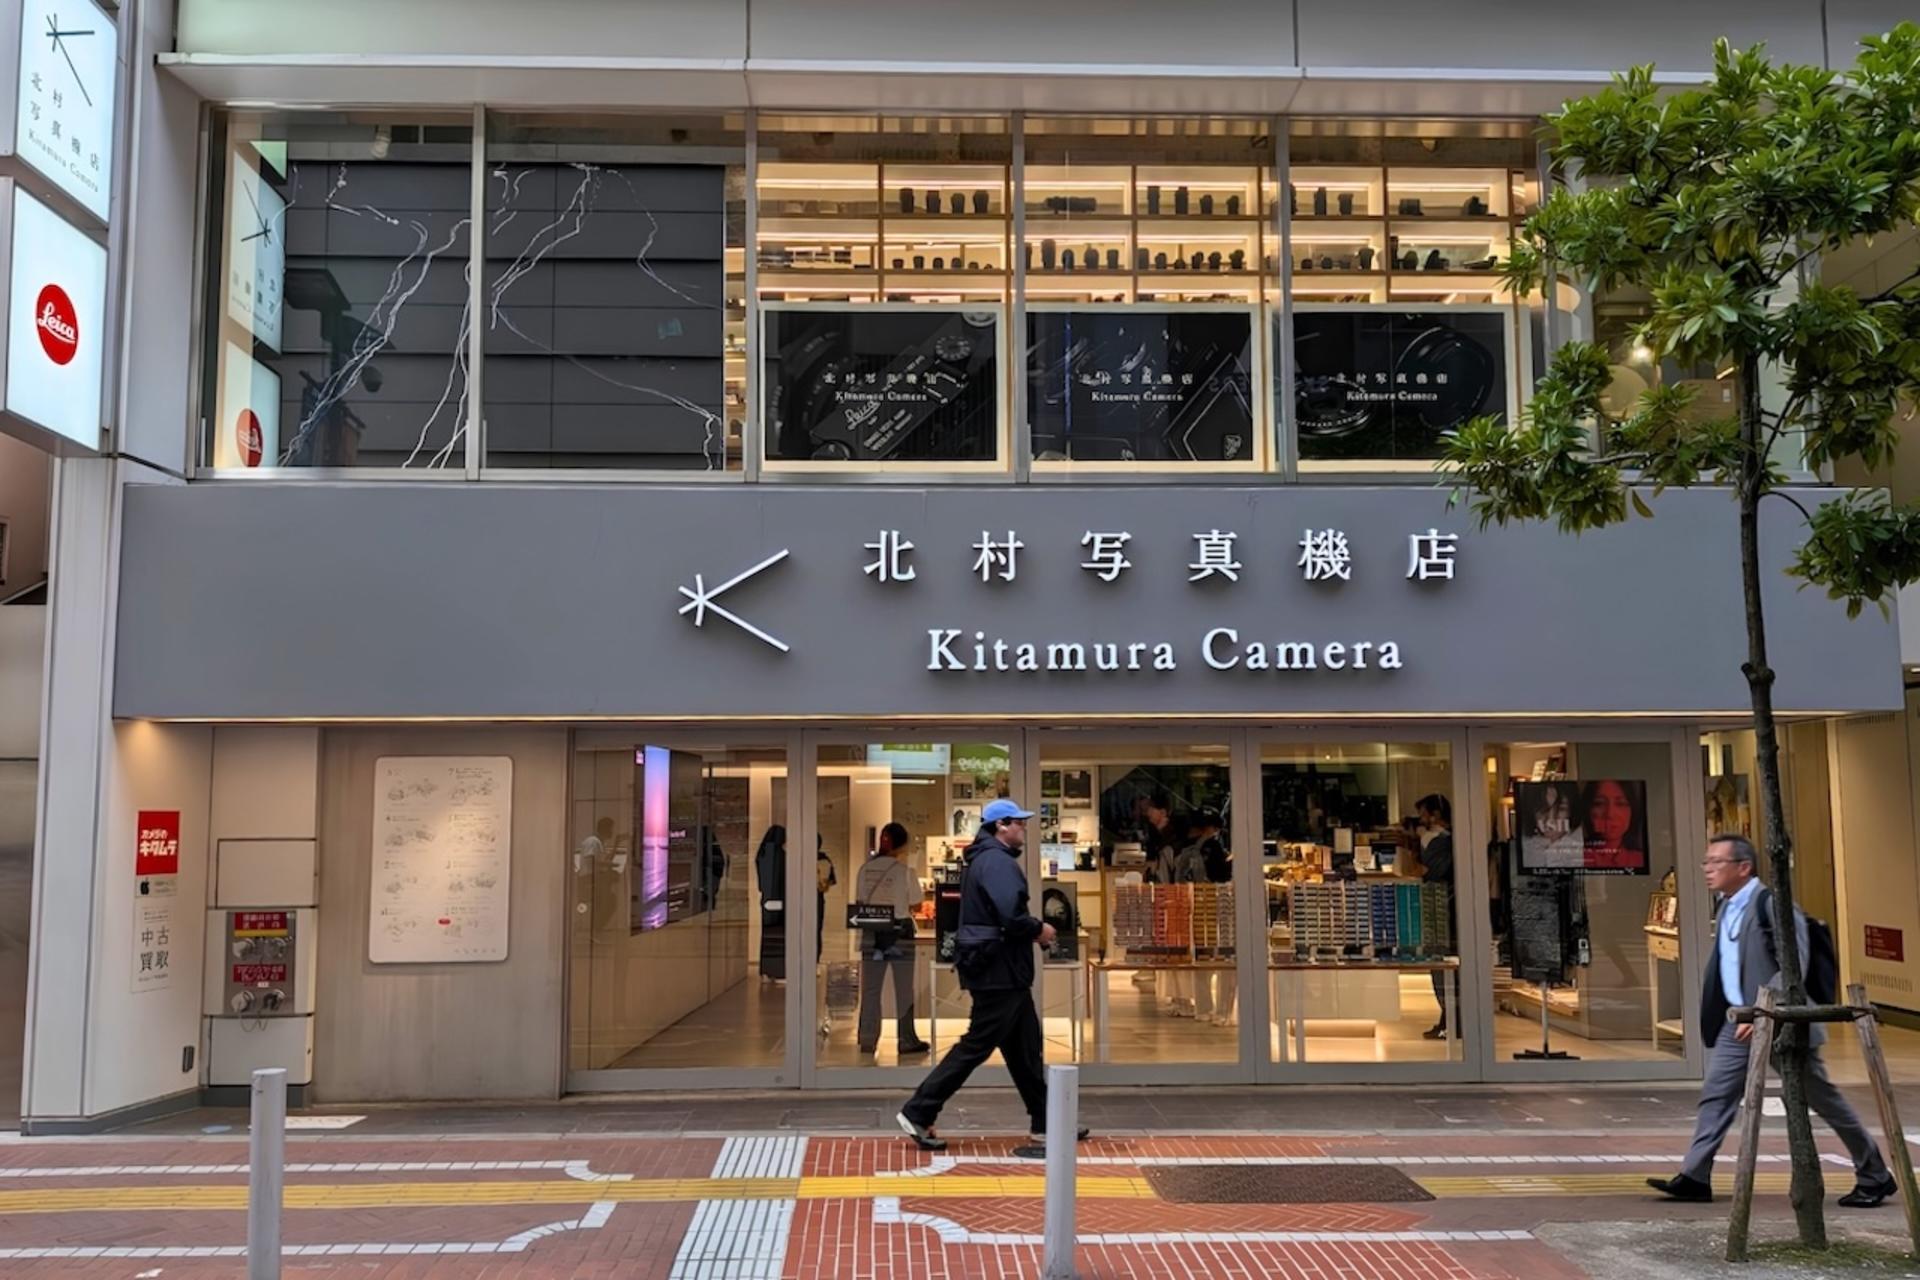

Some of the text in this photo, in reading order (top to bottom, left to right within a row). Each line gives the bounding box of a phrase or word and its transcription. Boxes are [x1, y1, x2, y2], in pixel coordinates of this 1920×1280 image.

[38, 301, 76, 344] Leica
[863, 529, 1459, 583] 北村写真機店
[927, 627, 1403, 672] Kitamura Camera
[140, 840, 178, 857] キタムラ
[141, 925, 170, 947] 中古
[140, 950, 169, 973] 買取
